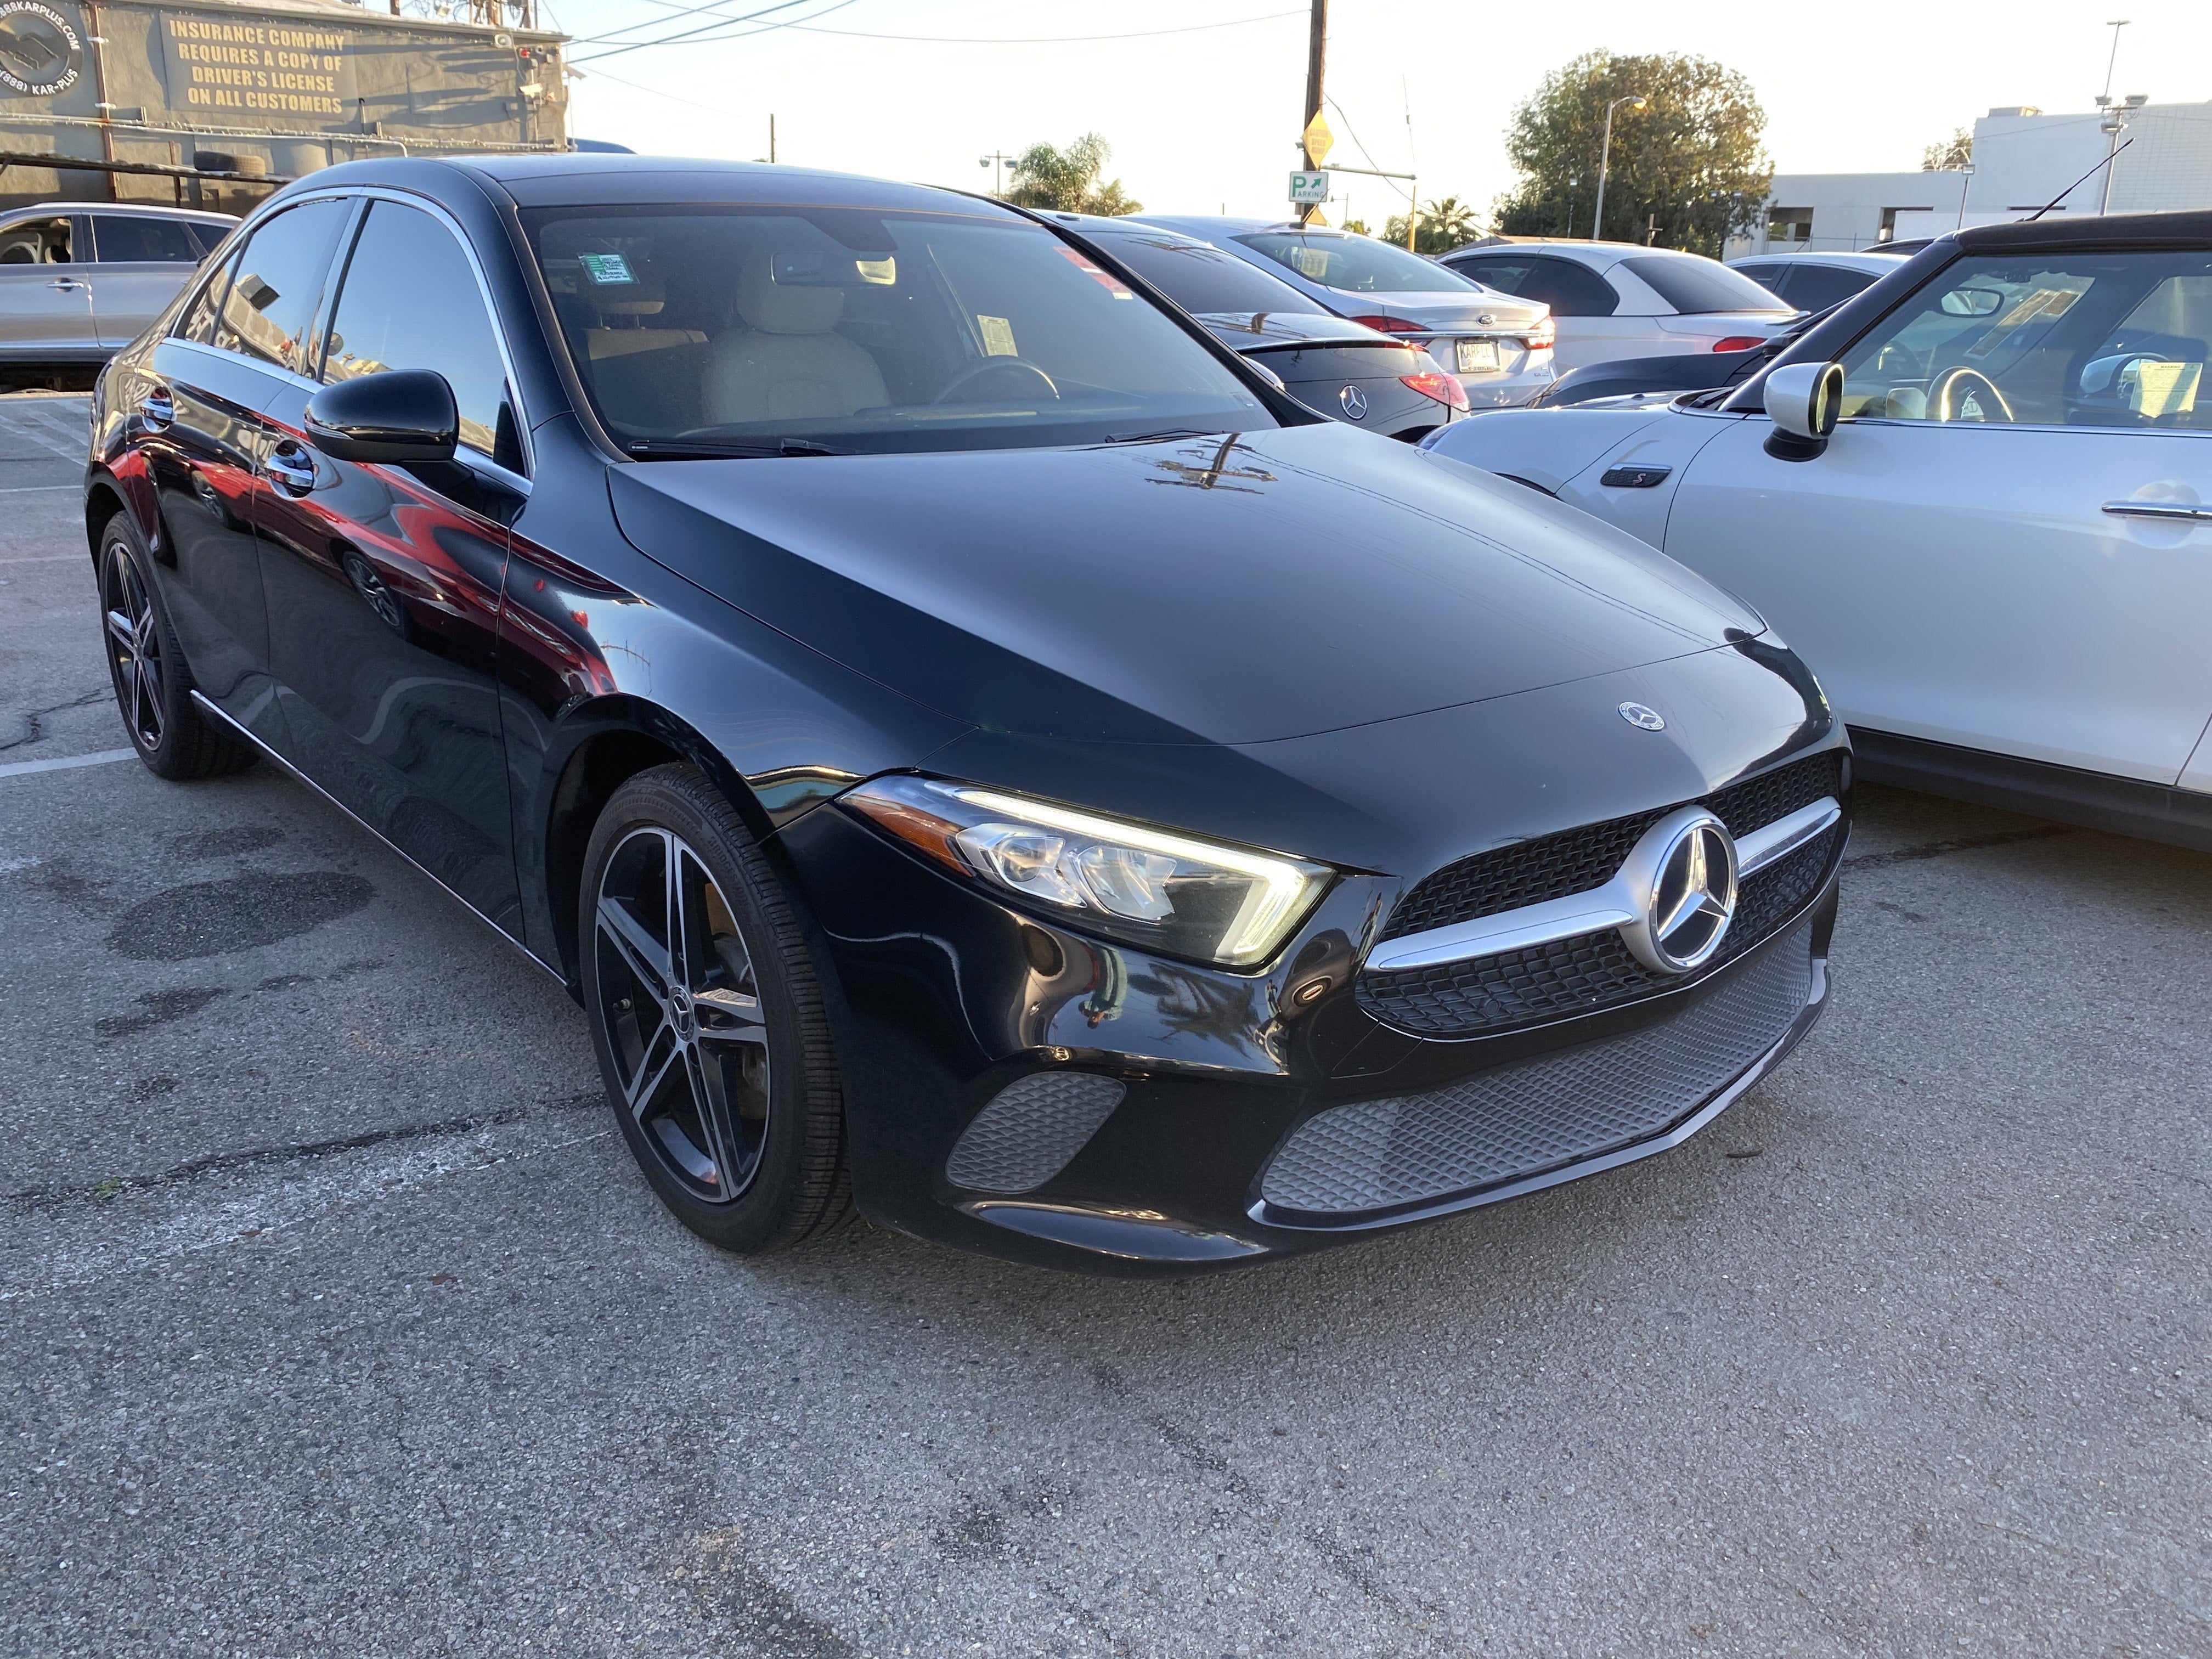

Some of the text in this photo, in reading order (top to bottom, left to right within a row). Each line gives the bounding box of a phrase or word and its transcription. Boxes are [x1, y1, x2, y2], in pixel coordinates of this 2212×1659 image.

[170, 20, 344, 50] INSURANCE COMPANY
[178, 42, 342, 72] REQUIRES A COPY OF
[32, 68, 78, 95] KAR-PLUS
[192, 65, 335, 92] DRIVER'S LICENSE
[188, 87, 342, 114] ON ALL CUSTOMERS
